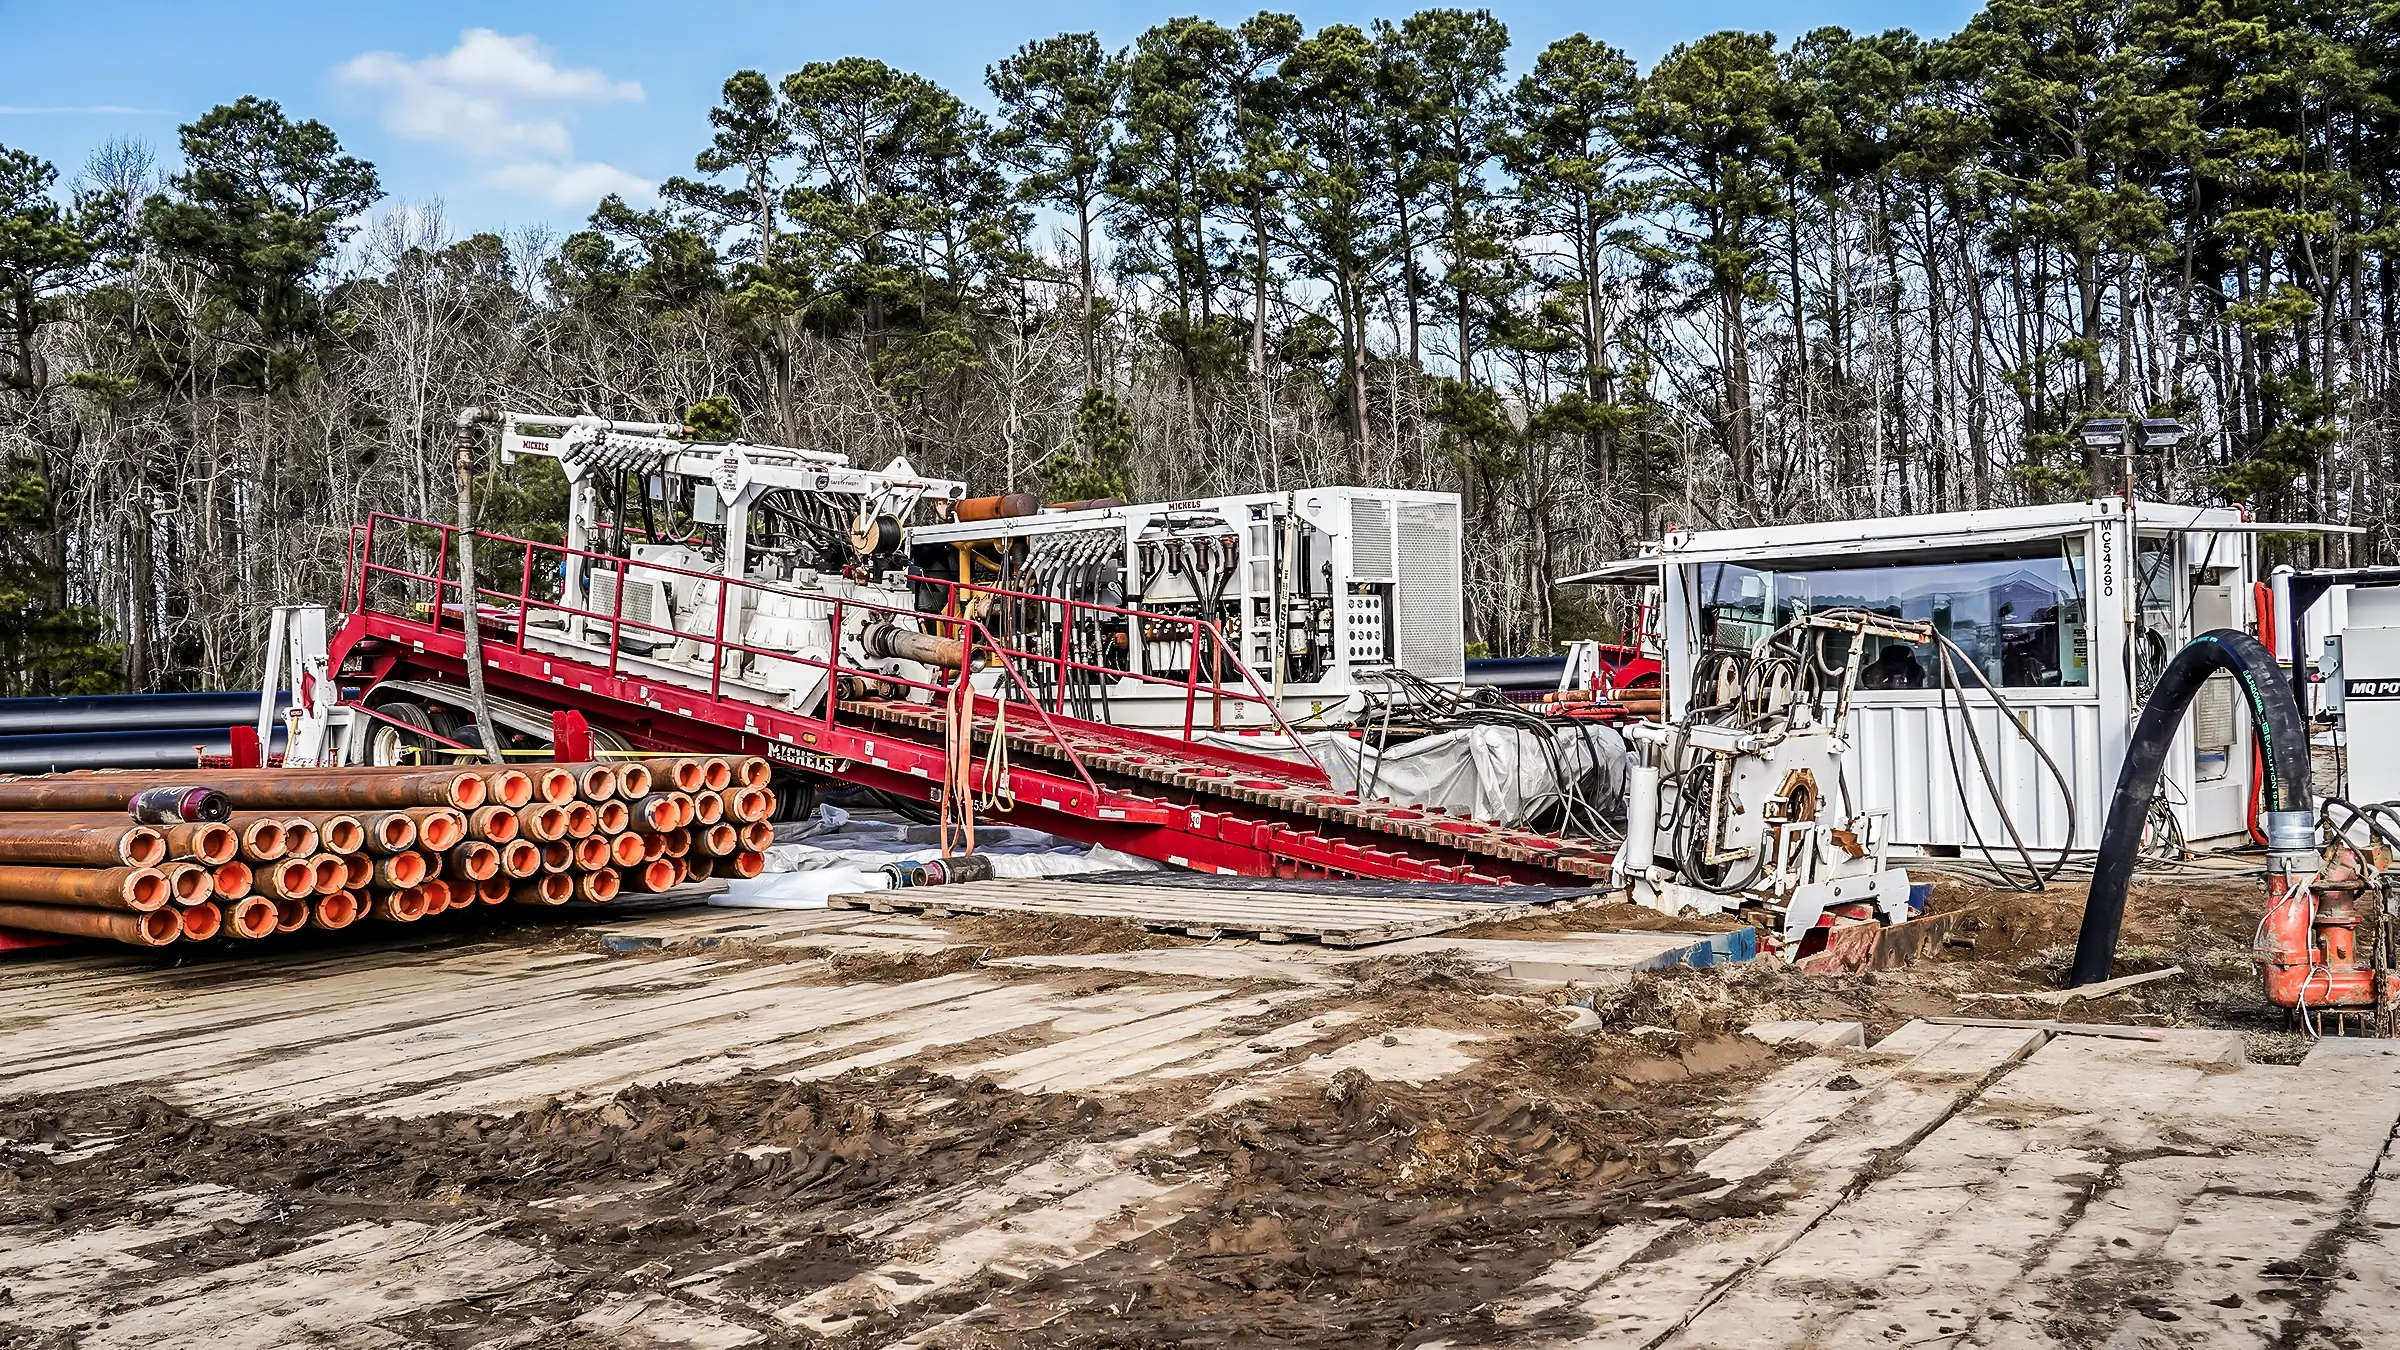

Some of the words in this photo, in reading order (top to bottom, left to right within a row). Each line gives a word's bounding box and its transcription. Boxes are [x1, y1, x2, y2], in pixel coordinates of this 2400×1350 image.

[2101, 520, 2113, 597] MC54290
[1278, 603, 1288, 649] ANCRA
[2351, 682, 2377, 696] MQ
[2377, 682, 2400, 694] PO
[767, 741, 834, 774] MICHELS
[2263, 734, 2278, 789] EVOLUTION
